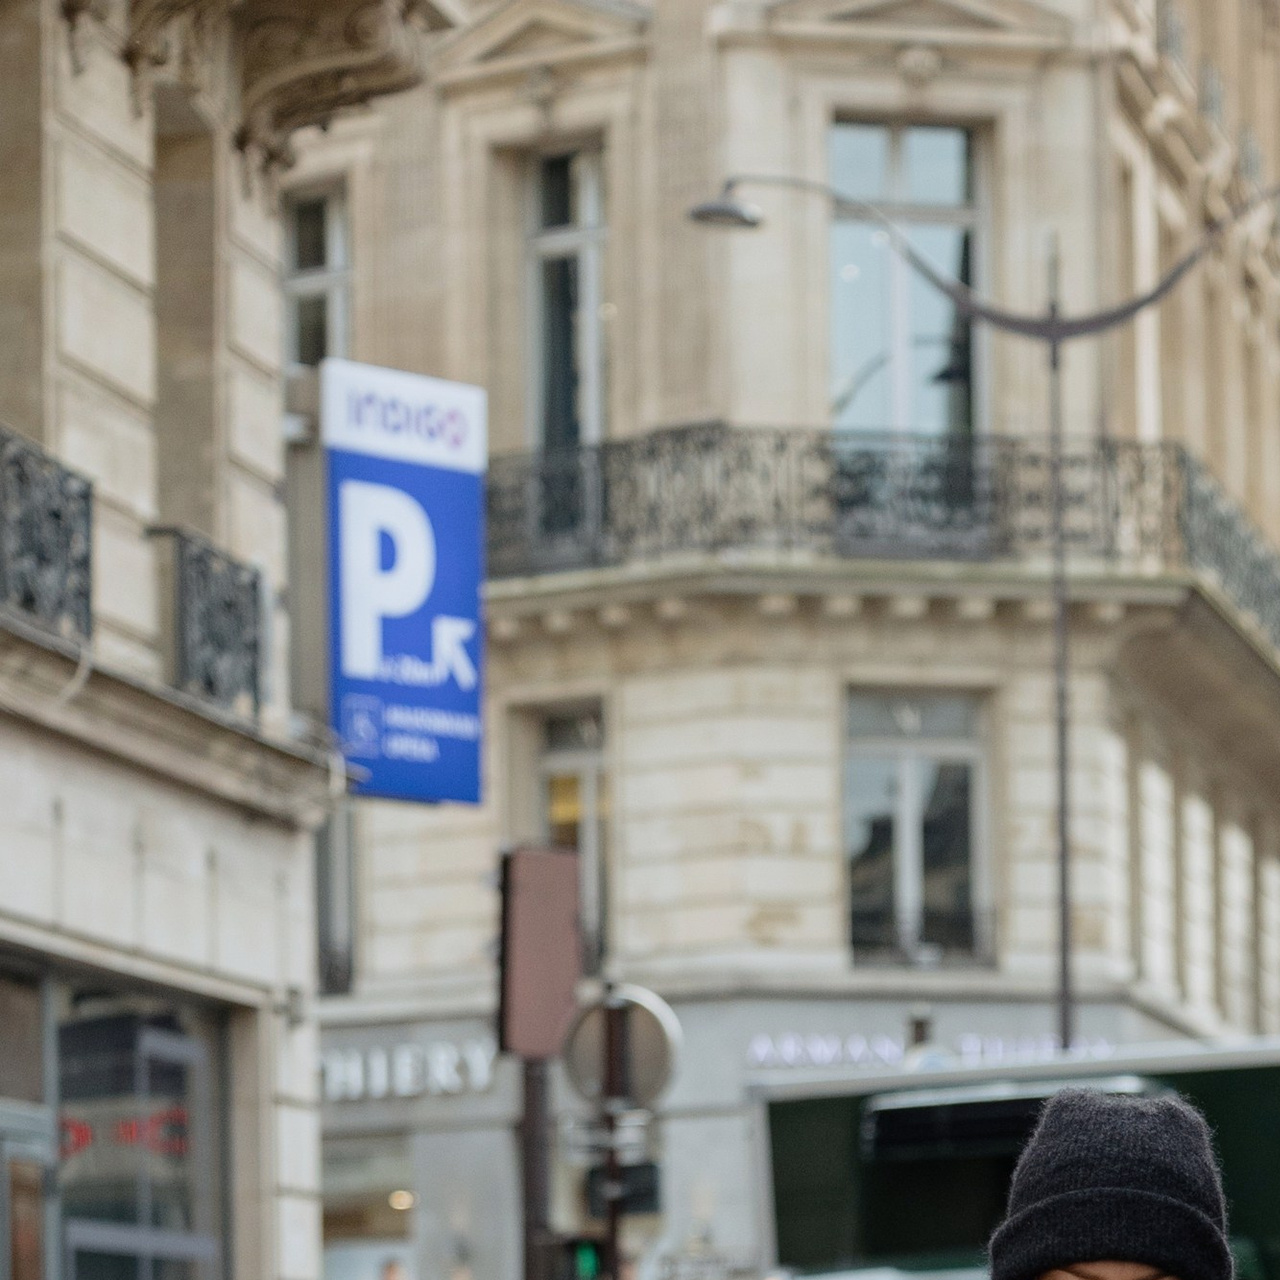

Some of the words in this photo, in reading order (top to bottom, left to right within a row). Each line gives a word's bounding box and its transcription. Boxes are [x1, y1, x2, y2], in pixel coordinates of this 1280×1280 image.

[339, 479, 438, 681] P
[321, 1041, 498, 1100] HIERY
[749, 1030, 903, 1066] ARMAN
